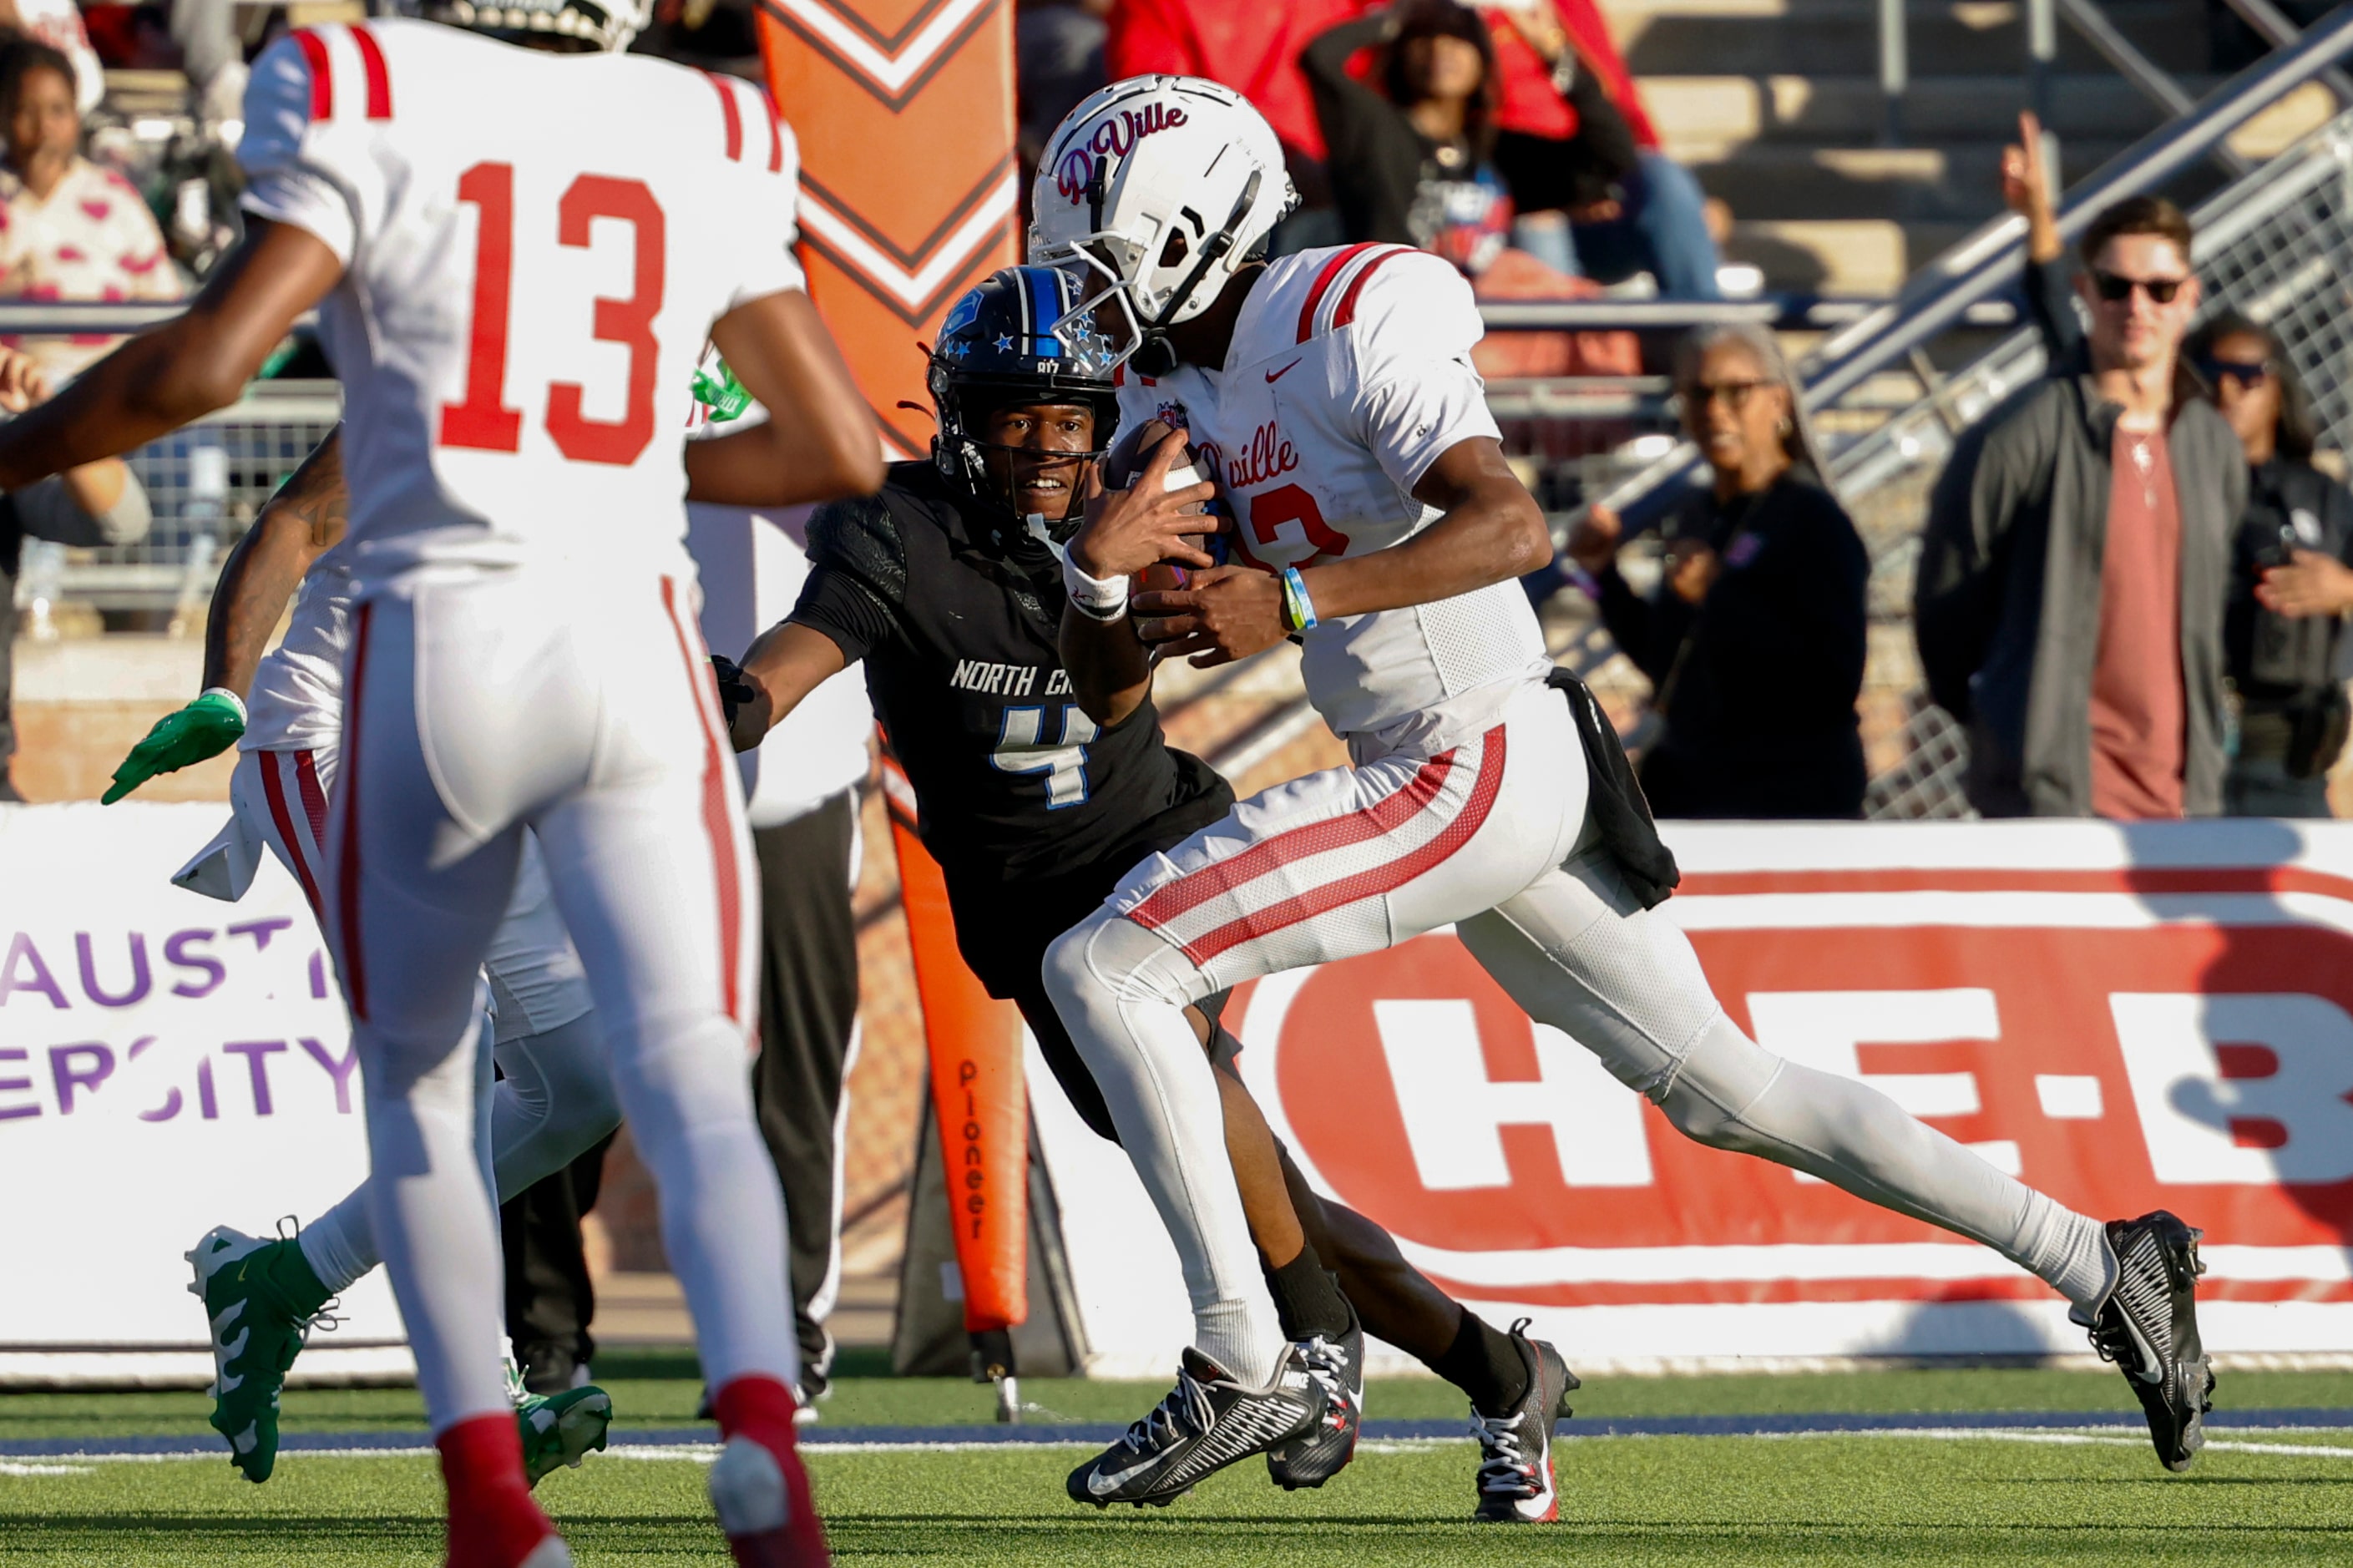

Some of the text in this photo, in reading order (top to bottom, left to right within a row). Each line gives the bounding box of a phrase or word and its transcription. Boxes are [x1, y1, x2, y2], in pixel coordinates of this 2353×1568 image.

[1057, 102, 1188, 205] D'Ville
[438, 159, 665, 468] 13
[1037, 362, 1060, 374] 817
[949, 659, 1038, 696] NORTH
[989, 704, 1102, 810] 4
[0, 916, 328, 1009] AUSTI
[1374, 988, 2353, 1189] HE-B
[959, 1060, 985, 1239] pioneer
[1279, 1370, 1310, 1389] NIKE
